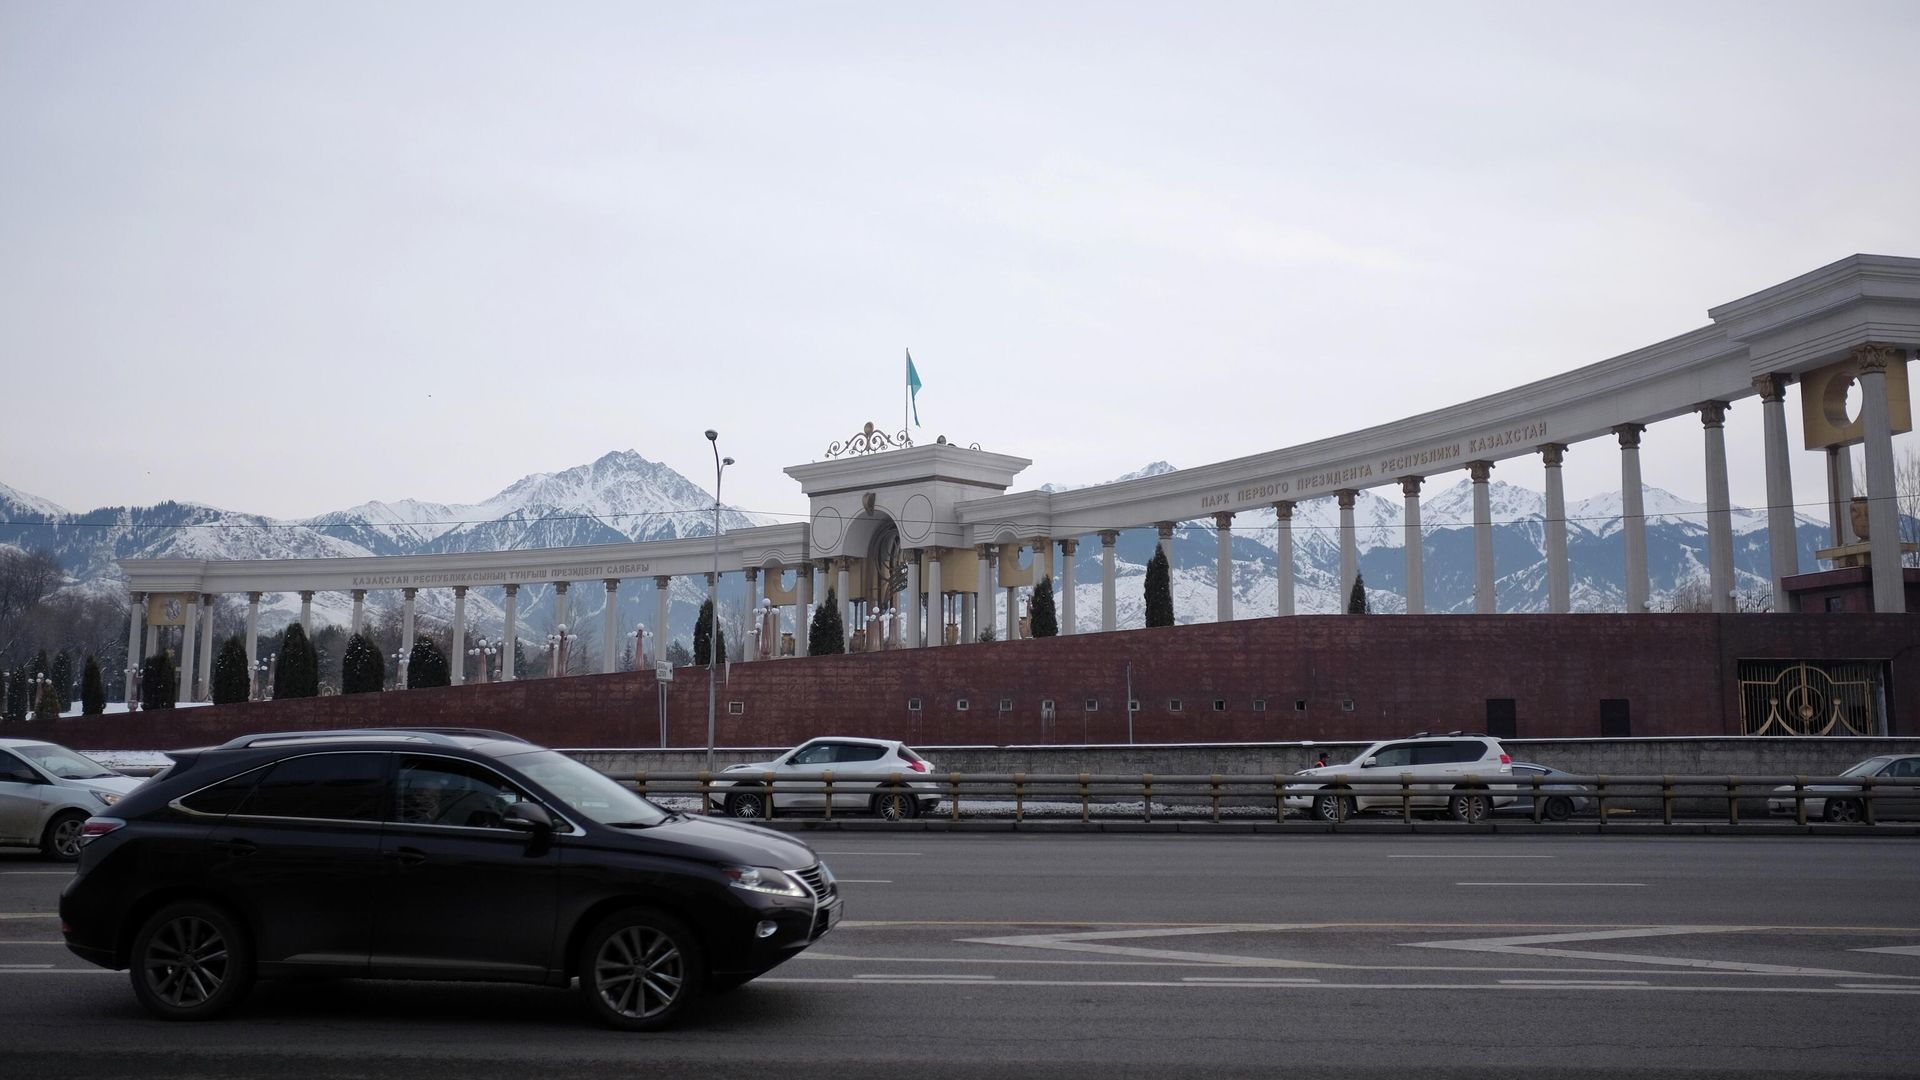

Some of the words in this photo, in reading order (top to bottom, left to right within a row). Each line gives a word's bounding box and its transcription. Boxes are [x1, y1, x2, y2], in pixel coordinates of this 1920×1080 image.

[1201, 493, 1230, 508] ПАРК
[1237, 482, 1289, 501] ПЕРВОГО
[1297, 464, 1373, 490] ПРЕЗИДЕНТА
[1381, 443, 1460, 473] РЕСПУБЛИКИ
[1470, 421, 1547, 453] КАЗАХСТАН
[352, 575, 409, 585] ҚАЗАҚСТАН
[606, 563, 649, 574] САЯБАҒЫ
